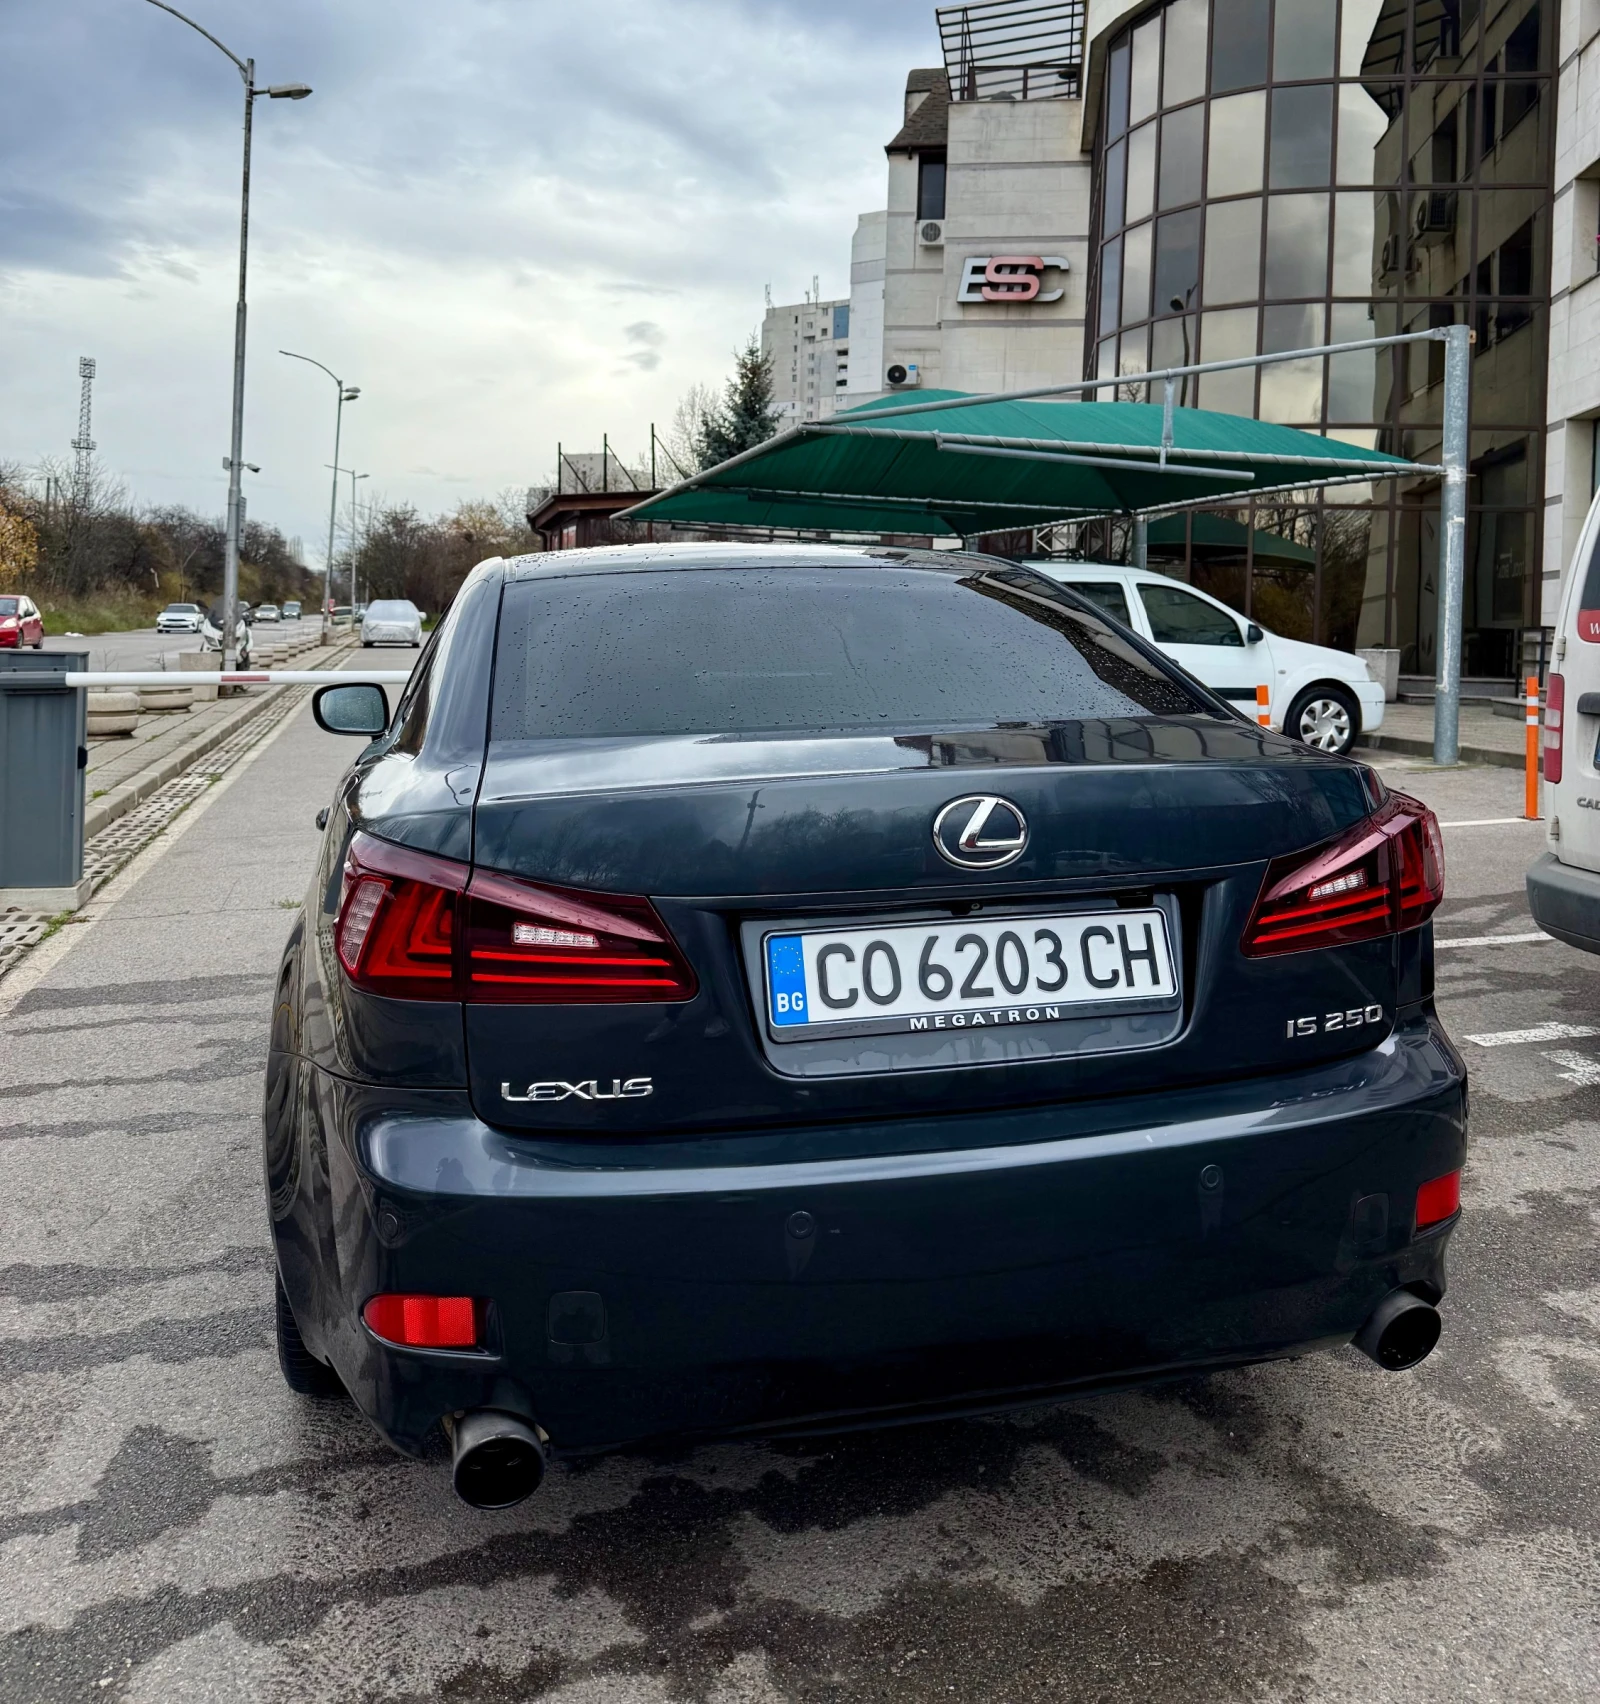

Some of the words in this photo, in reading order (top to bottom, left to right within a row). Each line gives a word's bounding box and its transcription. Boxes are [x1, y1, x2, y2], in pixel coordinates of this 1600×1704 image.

[816, 940, 902, 1009] CO
[918, 928, 1069, 1001] 6203
[1079, 923, 1162, 989] CH
[777, 991, 805, 1013] BG
[909, 1006, 1061, 1032] MEGATRON
[1286, 1016, 1318, 1039] IS
[1324, 1004, 1383, 1032] 250
[501, 1077, 653, 1101] LEXUS
